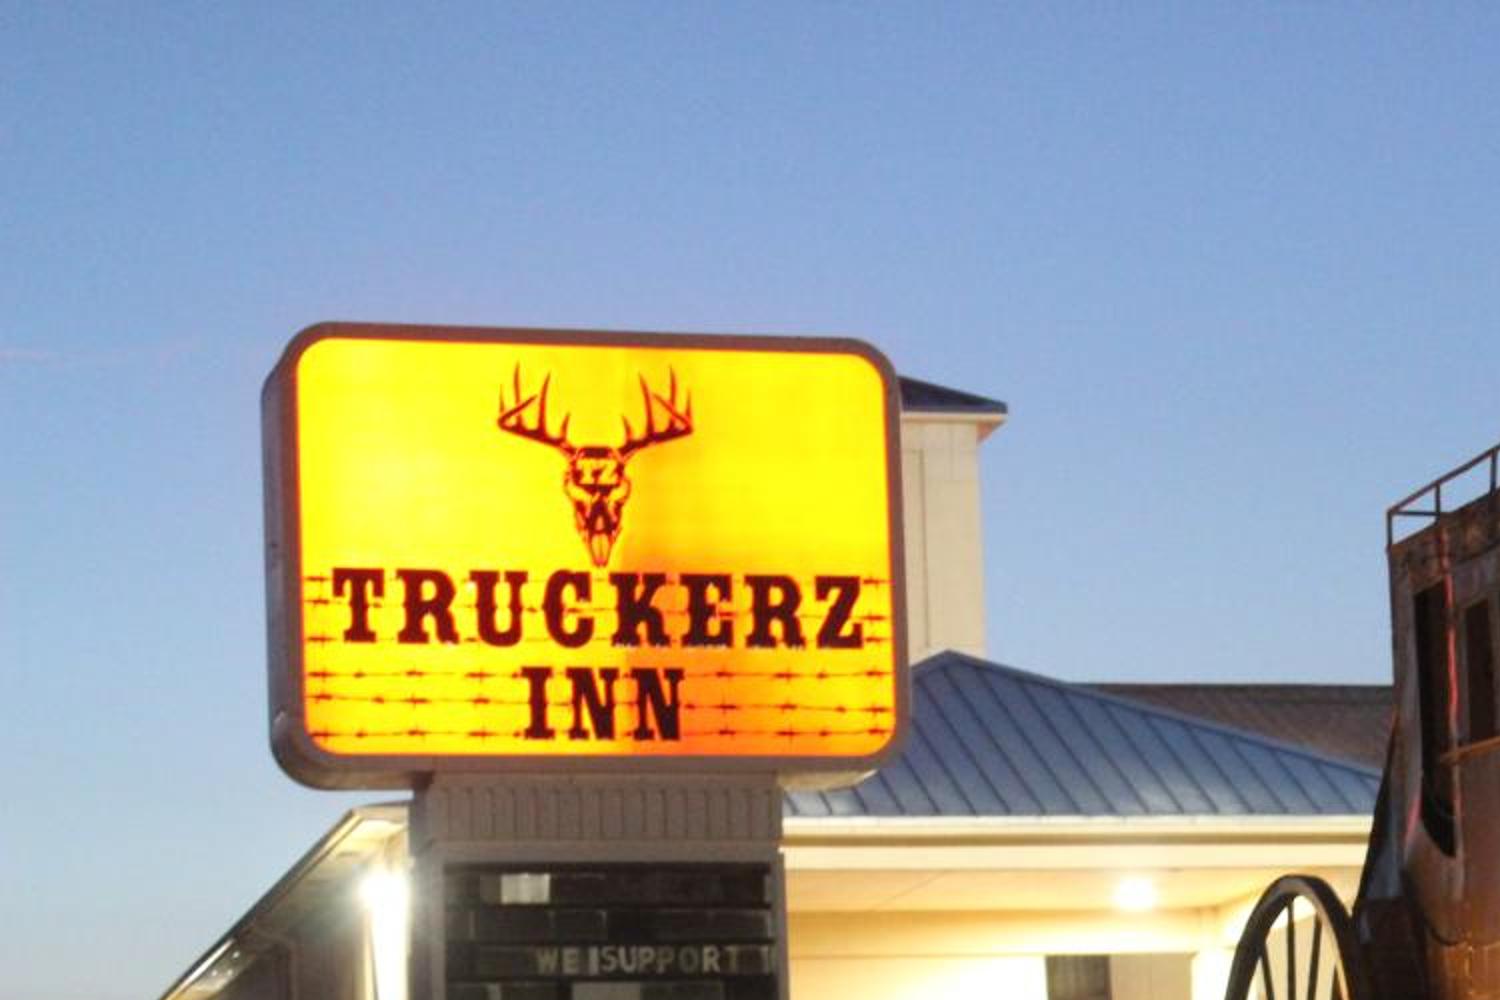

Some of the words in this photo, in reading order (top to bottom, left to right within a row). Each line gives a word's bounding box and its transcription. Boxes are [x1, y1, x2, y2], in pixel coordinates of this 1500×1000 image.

[332, 567, 864, 649] TRUCKERZ
[521, 666, 684, 740] INN
[536, 946, 578, 975] WE
[601, 945, 739, 974] SUPPORT
